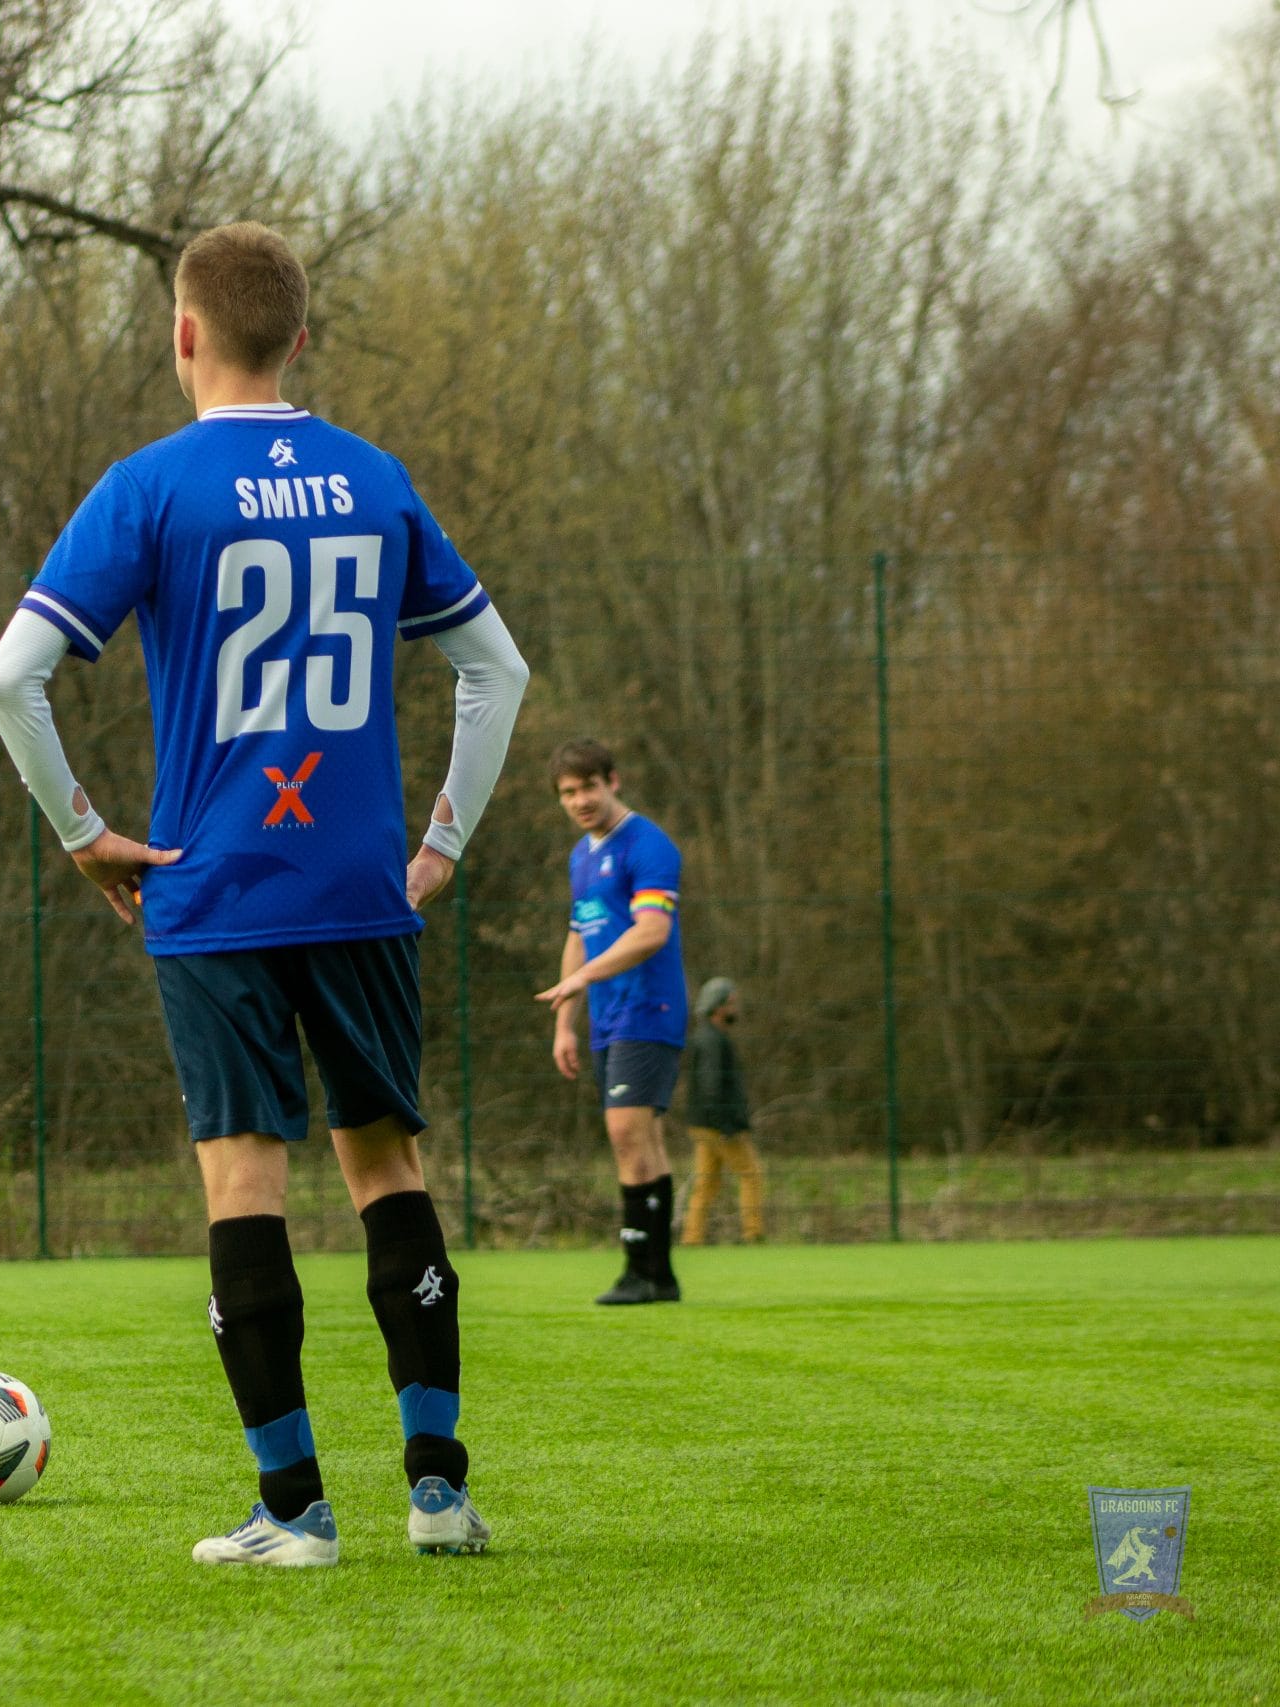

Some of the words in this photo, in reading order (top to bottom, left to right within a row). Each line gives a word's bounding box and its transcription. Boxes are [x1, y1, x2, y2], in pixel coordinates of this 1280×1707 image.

[236, 474, 353, 518] SMITS
[216, 535, 382, 743] 25
[262, 822, 315, 830] APPAREL
